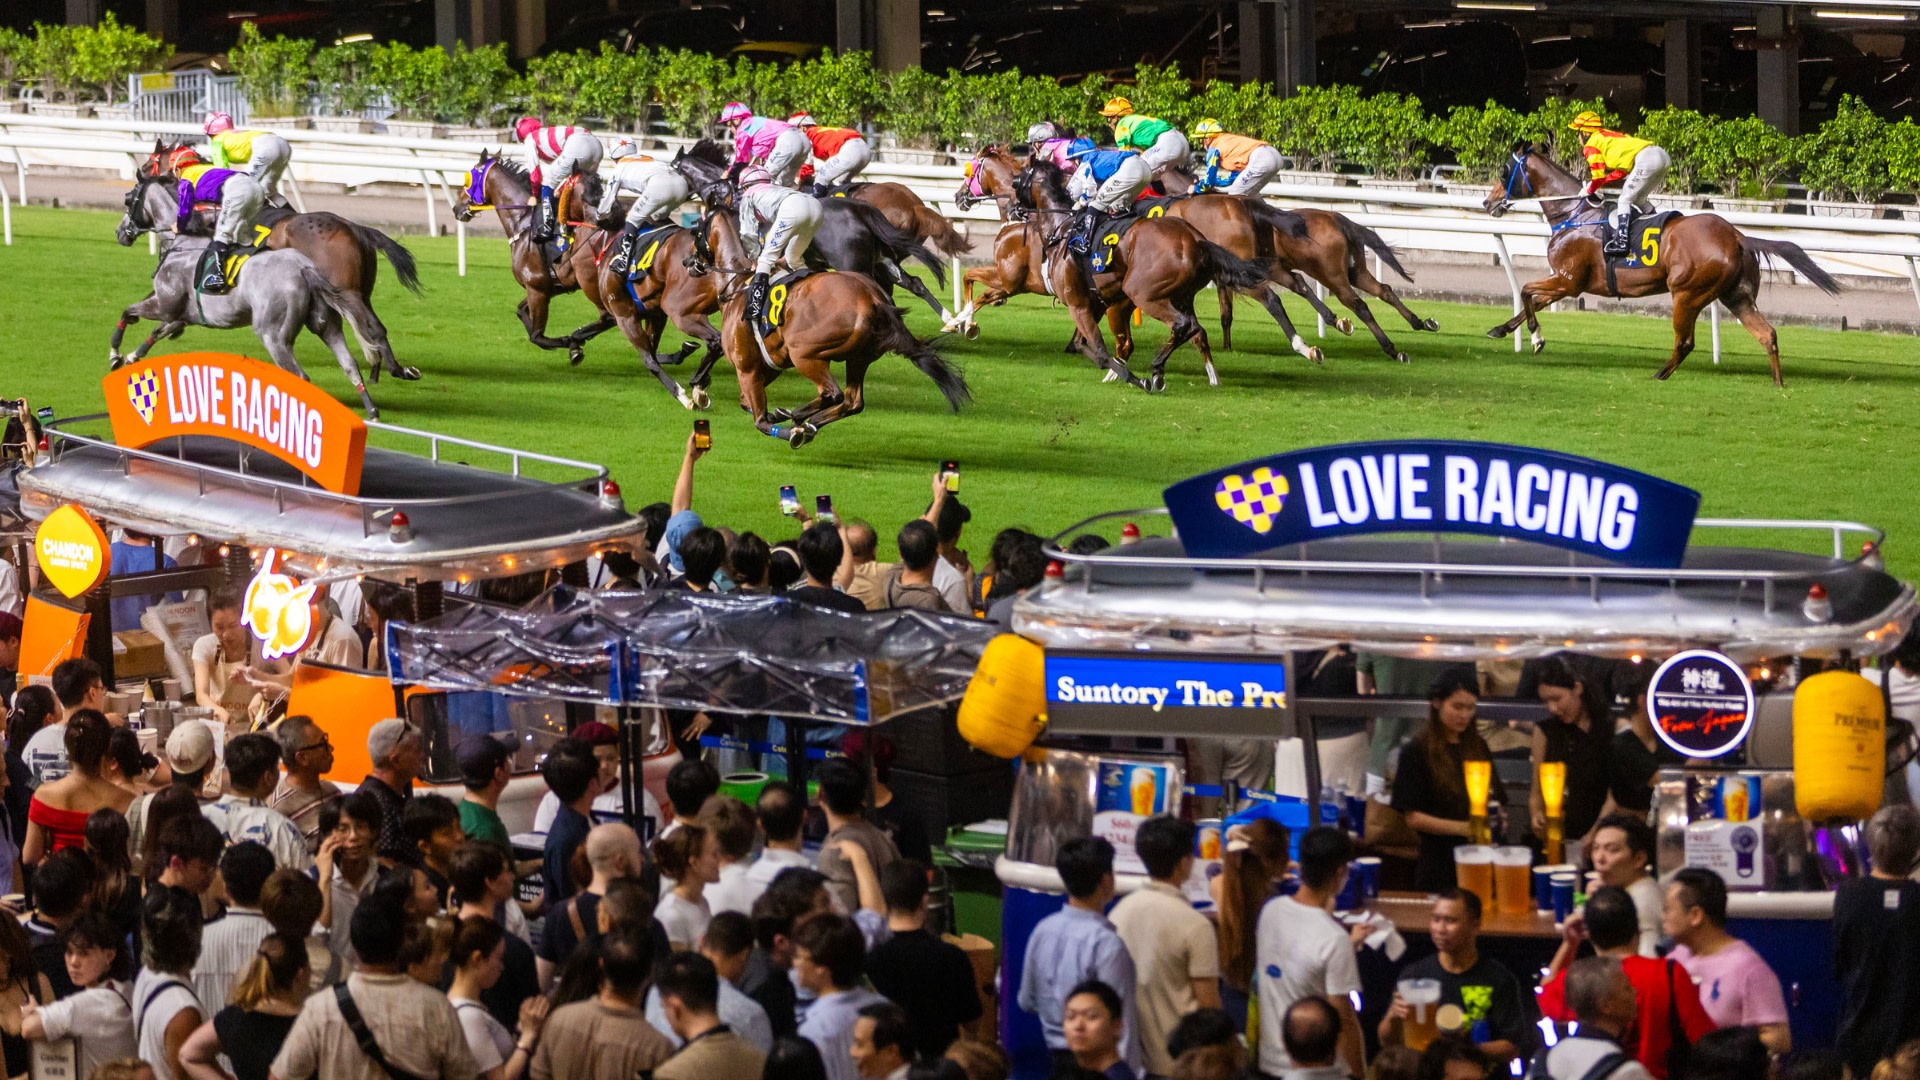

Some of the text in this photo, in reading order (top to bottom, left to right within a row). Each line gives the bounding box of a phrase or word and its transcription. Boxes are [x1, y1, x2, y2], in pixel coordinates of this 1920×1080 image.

[253, 224, 272, 247] 7
[1640, 227, 1662, 267] 5
[637, 239, 660, 271] 4
[768, 283, 788, 327] 8
[163, 364, 323, 469] LOVE RACING
[1297, 453, 1640, 552] LOVE RACING
[42, 537, 94, 563] CHANDON
[1057, 675, 1169, 712] Suntory
[1175, 679, 1234, 707] The
